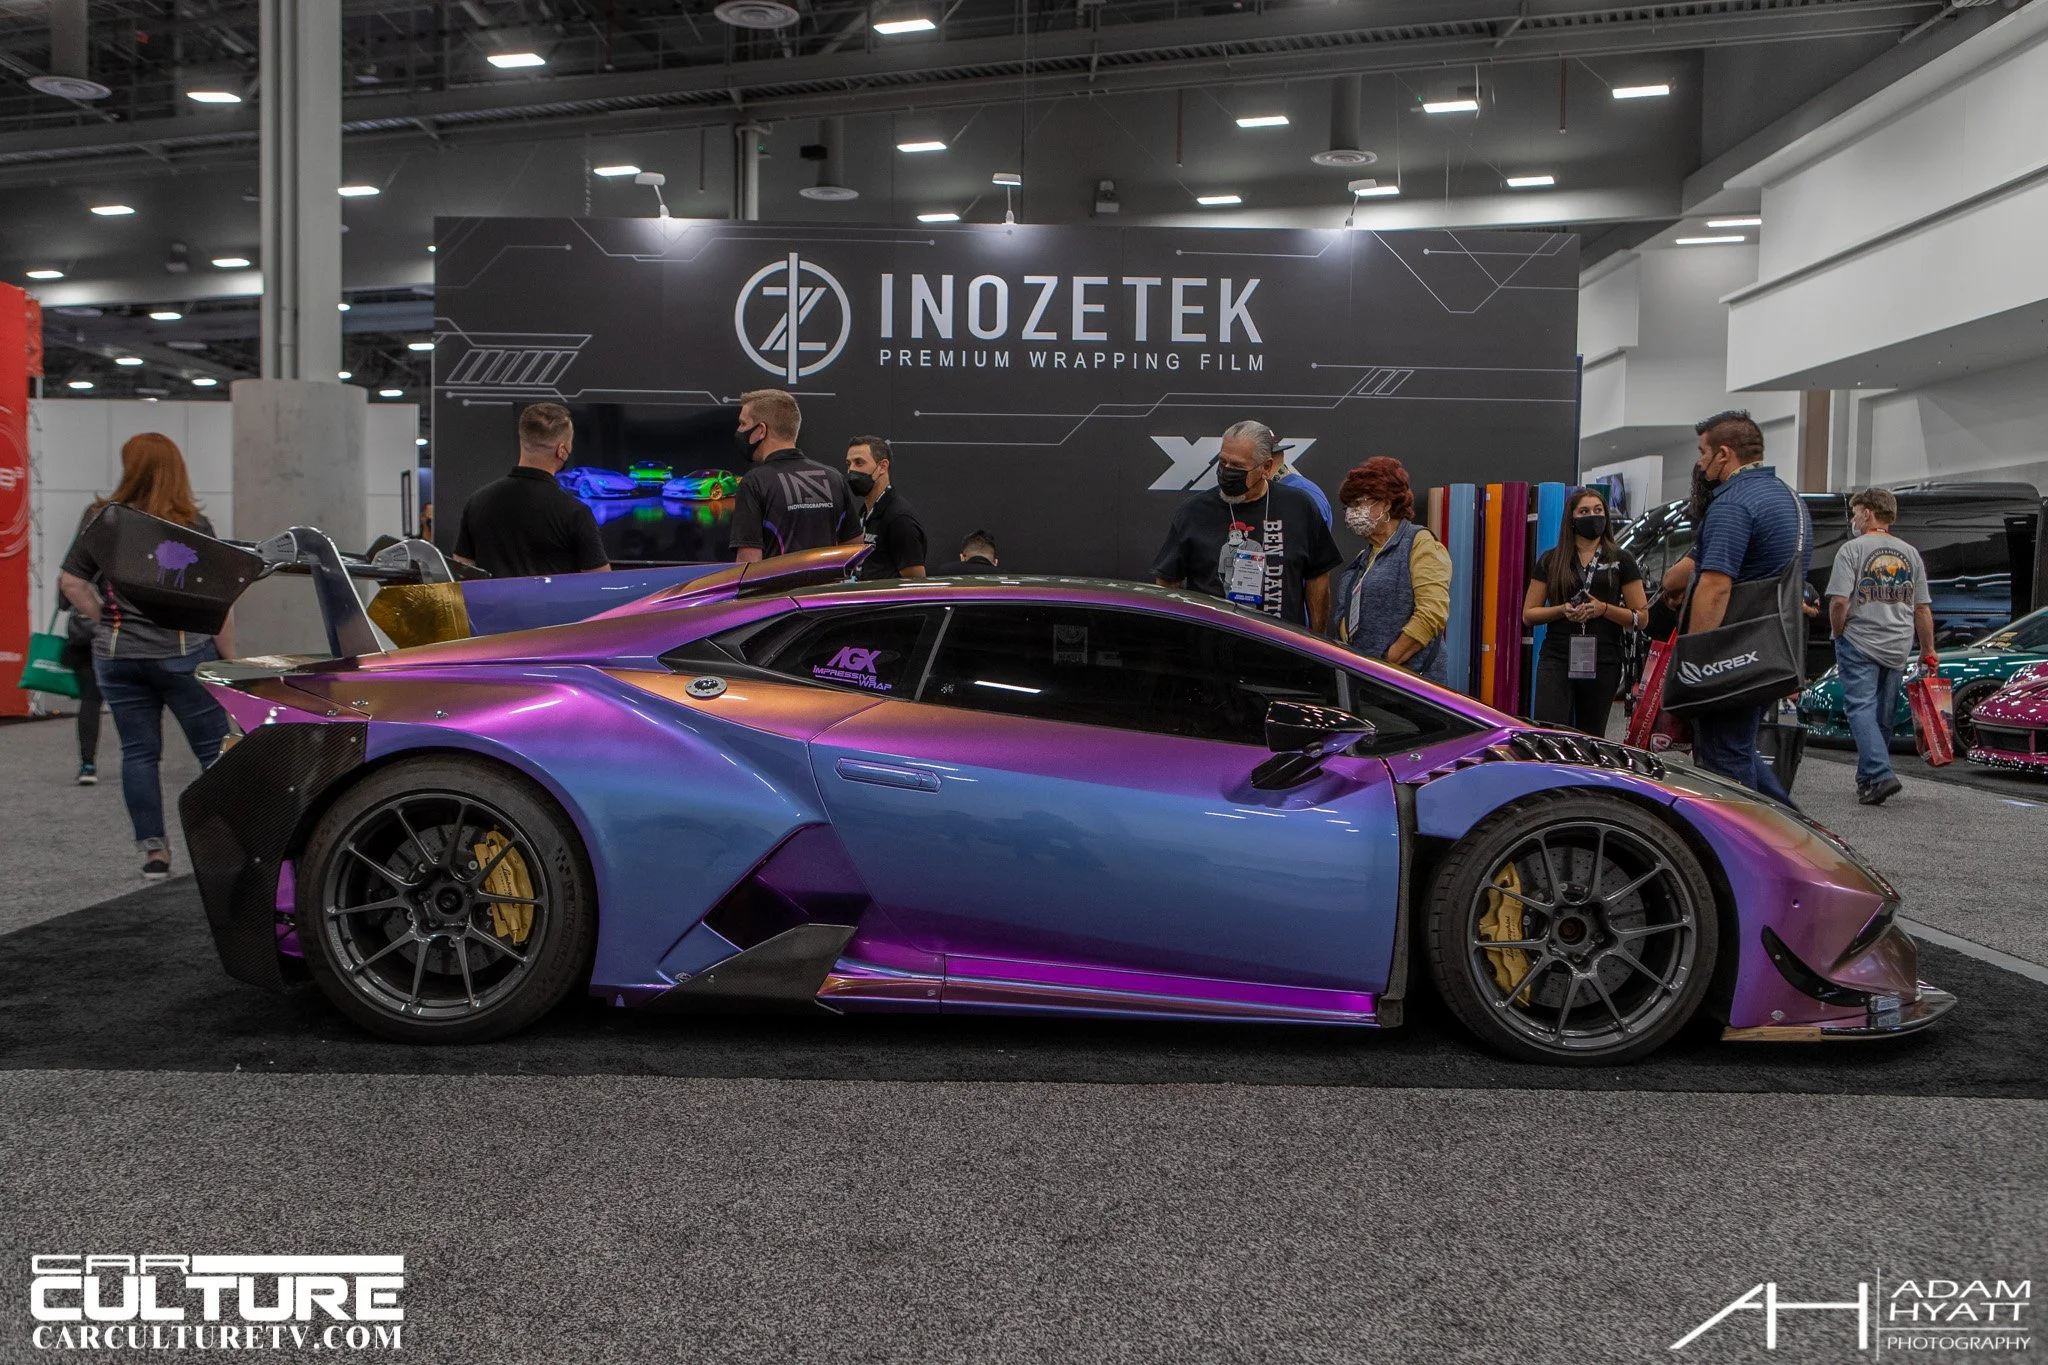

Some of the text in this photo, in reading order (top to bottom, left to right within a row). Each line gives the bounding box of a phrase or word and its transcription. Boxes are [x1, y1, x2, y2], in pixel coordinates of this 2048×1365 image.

[881, 273, 1263, 343] INOZETEK
[880, 350, 1263, 371] PREMIUM WRAPPING FILM
[1263, 520, 1284, 557] BEN
[827, 646, 881, 674] AGX
[813, 665, 877, 681] IMPRESSIVE
[859, 680, 892, 691] WRAP
